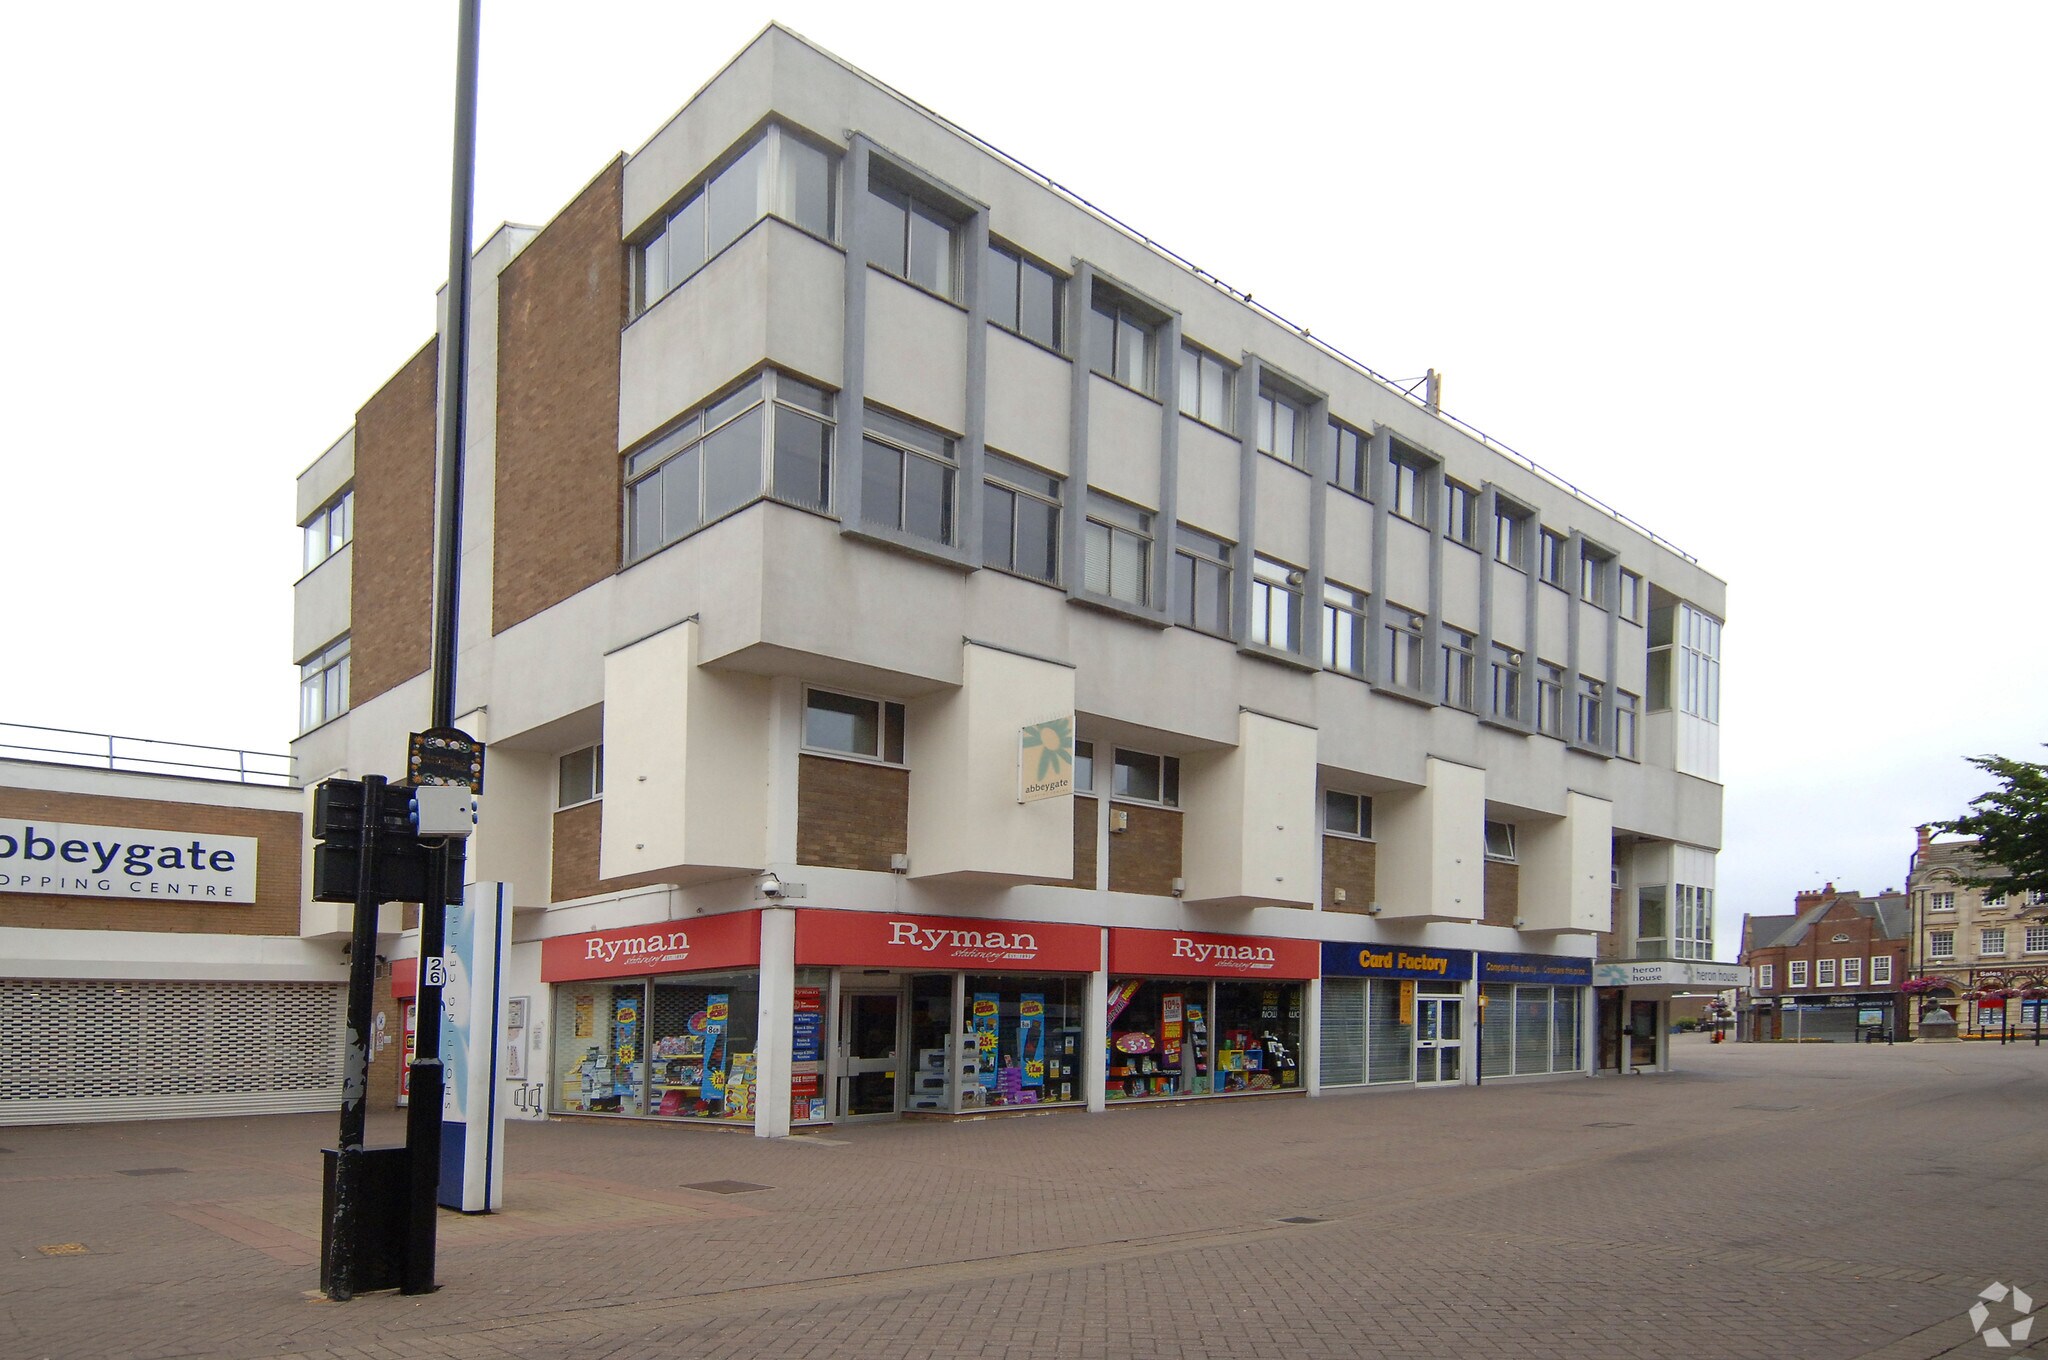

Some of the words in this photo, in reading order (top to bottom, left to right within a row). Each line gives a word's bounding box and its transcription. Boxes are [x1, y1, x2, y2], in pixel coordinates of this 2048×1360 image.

[1025, 779, 1068, 794] abbeygate
[130, 881, 233, 896] CENTRE
[888, 922, 1038, 951] Ryman
[584, 932, 690, 962] Ryman
[1172, 938, 1275, 962] Ryman
[951, 948, 1004, 962] stationery
[1359, 950, 1393, 968] Card
[1398, 952, 1448, 974] Factory
[1215, 960, 1252, 972] stationery
[1696, 969, 1716, 981] heron
[1718, 970, 1738, 982] house
[1140, 1039, 1147, 1049] 2
[445, 997, 456, 1108] SHOPPING
